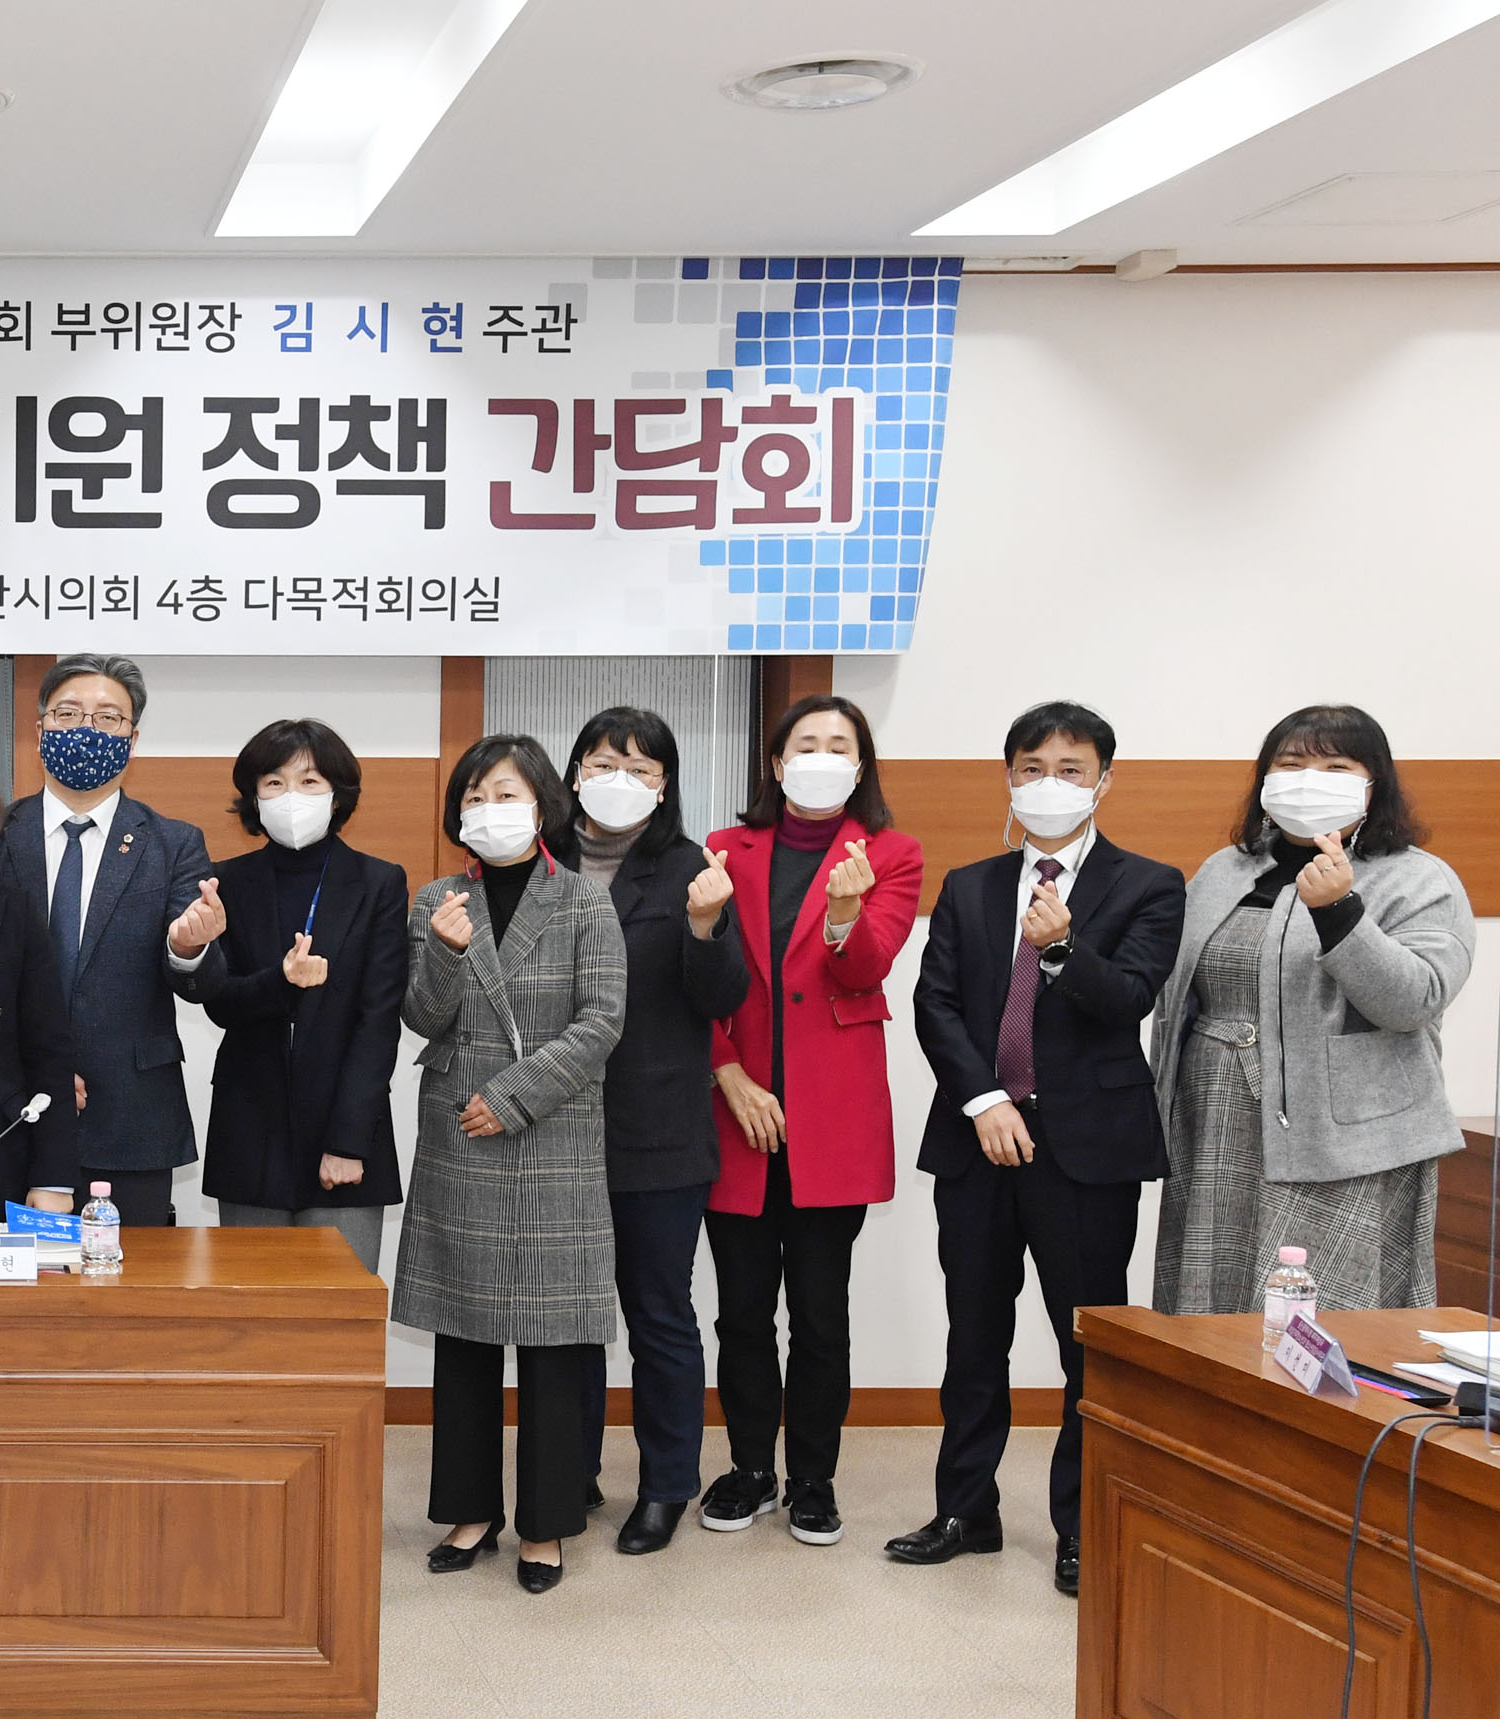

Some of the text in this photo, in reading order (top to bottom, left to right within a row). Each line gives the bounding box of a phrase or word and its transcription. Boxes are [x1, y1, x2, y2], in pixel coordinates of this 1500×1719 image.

[50, 301, 242, 353] 부위원장
[482, 302, 578, 354] 주관
[202, 394, 447, 530] 정책
[487, 393, 855, 531] 간담회
[156, 575, 227, 622] 4층
[244, 575, 500, 622] 다목적회의실
